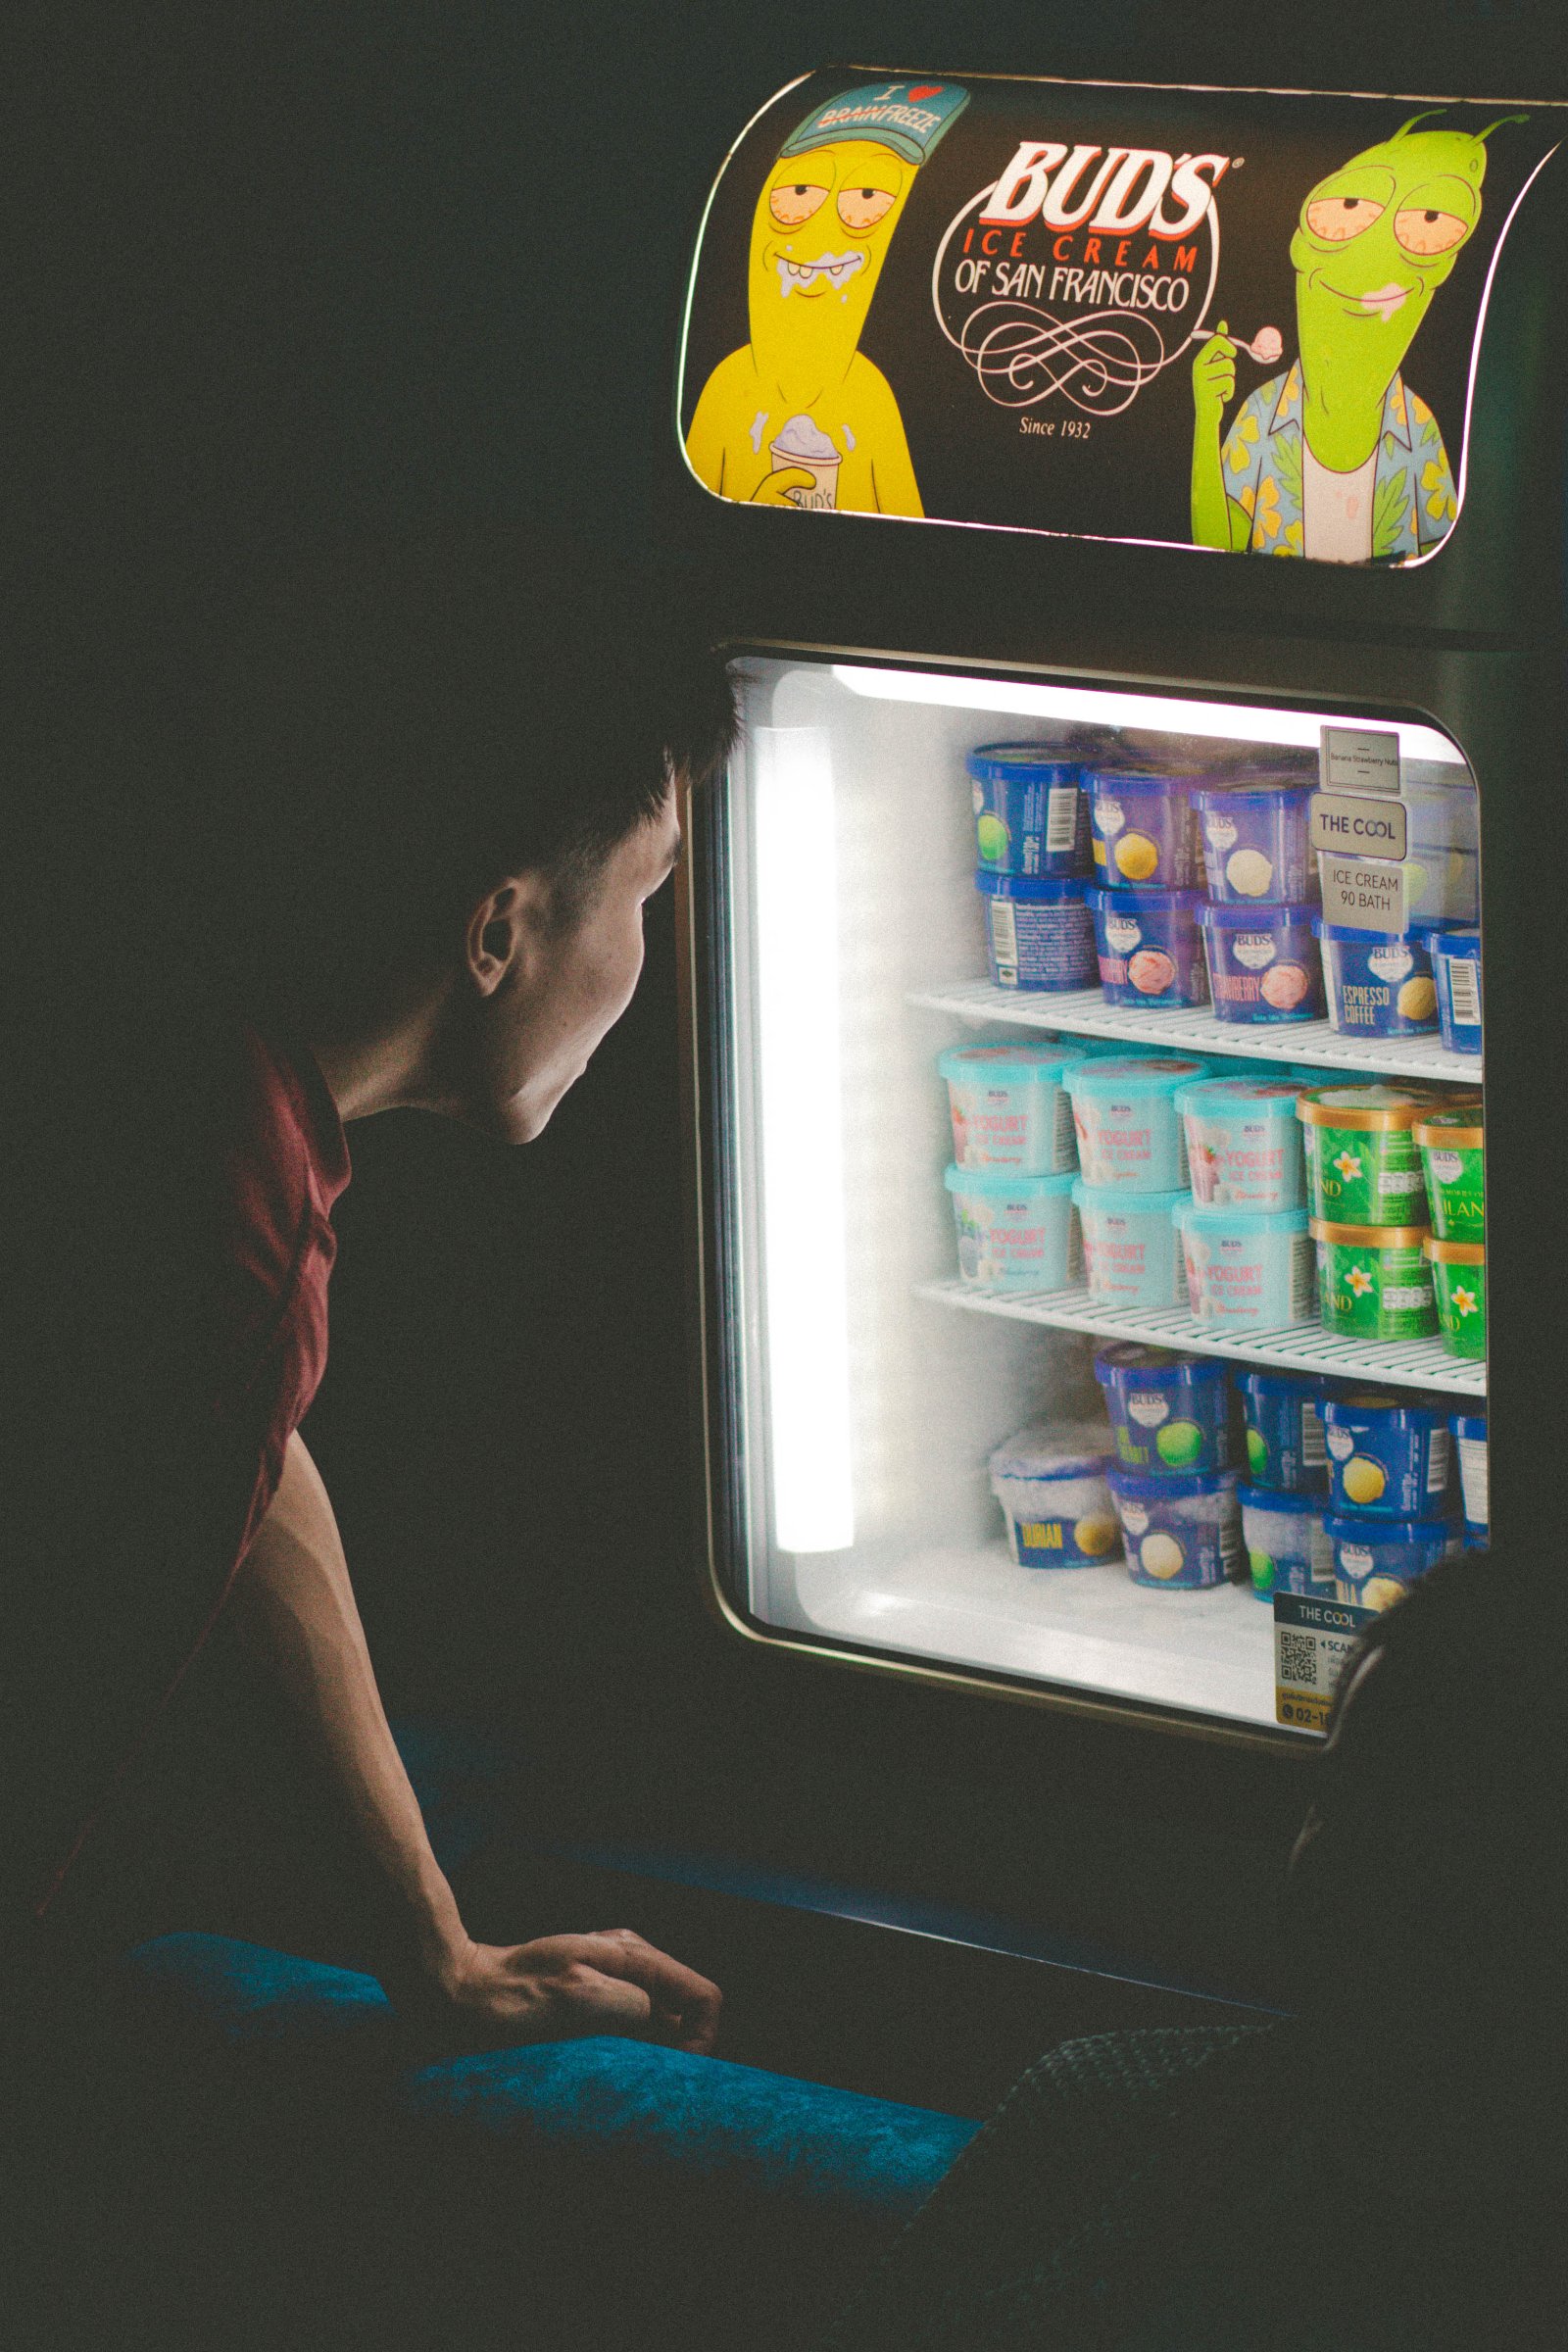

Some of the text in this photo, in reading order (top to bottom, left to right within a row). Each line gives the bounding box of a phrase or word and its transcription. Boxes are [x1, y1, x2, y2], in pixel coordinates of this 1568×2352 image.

[873, 84, 906, 101] I
[979, 141, 1230, 241] BUD'S
[962, 227, 1198, 272] ICE CREAM
[955, 259, 1190, 313] OF SAN FRANCISCO
[1019, 416, 1091, 439] Since 1932
[1330, 752, 1351, 762] Banana
[1352, 755, 1385, 766] Strawberry
[1320, 813, 1396, 840] THE COOL
[1333, 869, 1398, 892] ICE CREAM
[1341, 890, 1391, 910] 90 BATH
[1343, 985, 1390, 1006] ESPRESSO
[1345, 1004, 1375, 1025] COFFEE
[973, 1115, 1028, 1132] YOGURT
[1098, 1128, 1151, 1147] YOGURT
[1226, 1148, 1284, 1167] YOGURT
[989, 1227, 1046, 1246] YOGURT
[1206, 1264, 1263, 1283] YOGURT
[1298, 1605, 1356, 1628] THE COOL
